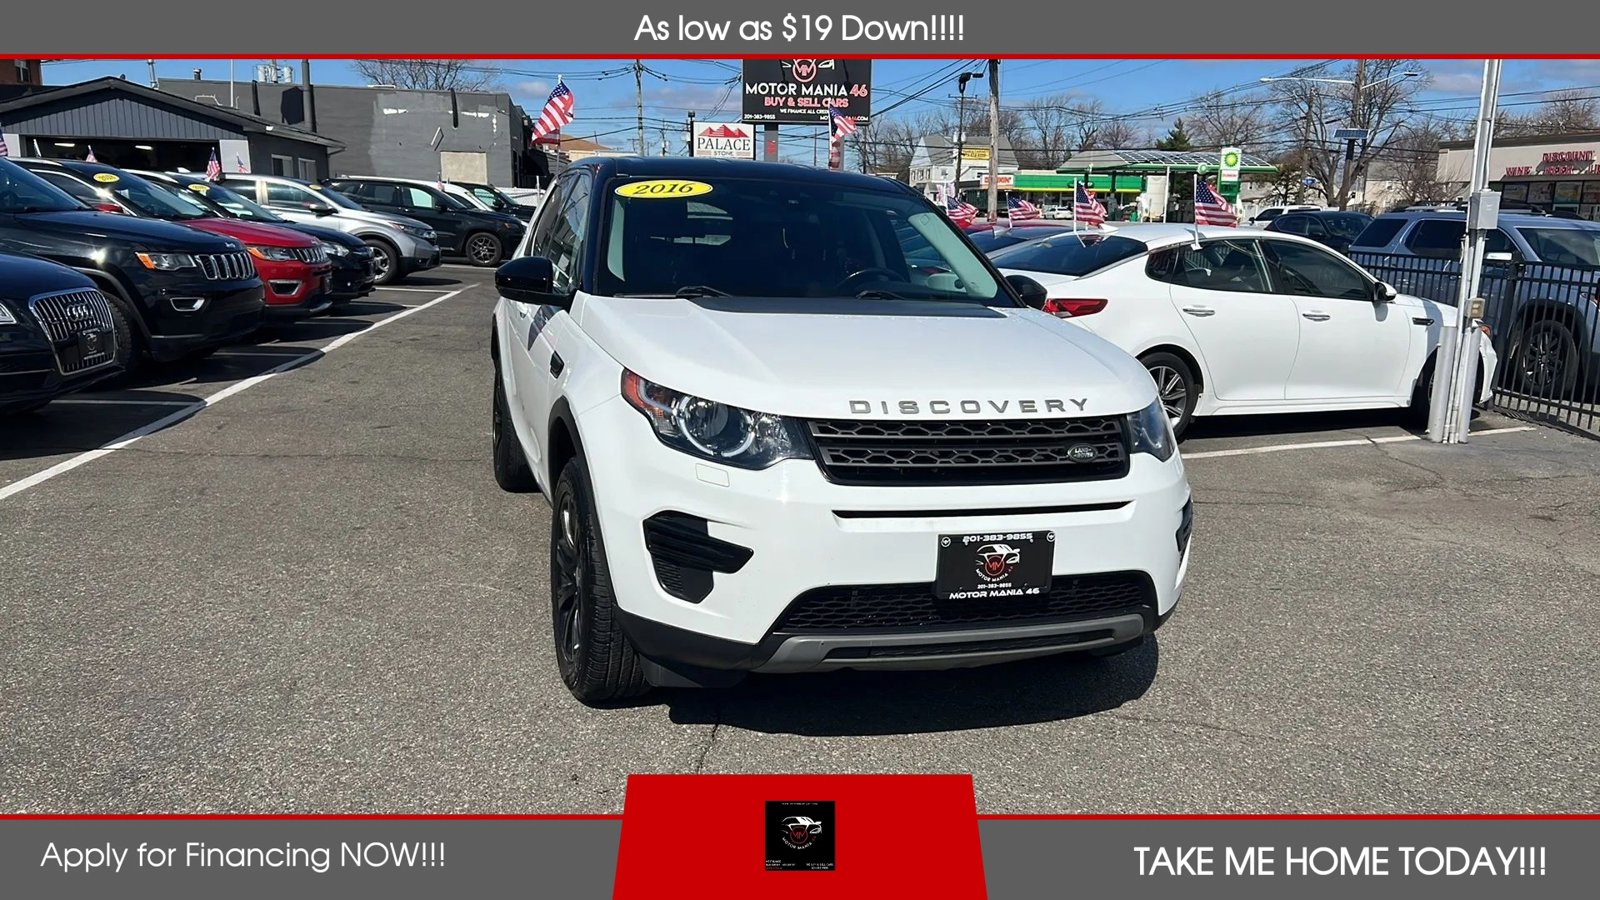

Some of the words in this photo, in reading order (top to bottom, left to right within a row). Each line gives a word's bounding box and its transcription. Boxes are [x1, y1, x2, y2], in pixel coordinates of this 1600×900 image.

[745, 82, 797, 95] MOTOR
[801, 84, 848, 97] MANIA
[849, 84, 868, 97] 46
[764, 96, 785, 107] BUY
[787, 97, 796, 107] &
[797, 97, 821, 108] SELL
[822, 97, 849, 108] CARS
[697, 137, 751, 151] PALACE
[1542, 150, 1594, 162] DISCOUNT
[1505, 166, 1532, 176] WINE
[632, 183, 696, 195] 2016
[848, 398, 1088, 415] DISCOVERY
[962, 533, 1033, 542] 201-383-9855
[949, 590, 988, 600] MOTOR
[989, 588, 1024, 597] MANIA
[1025, 586, 1040, 595] 46
